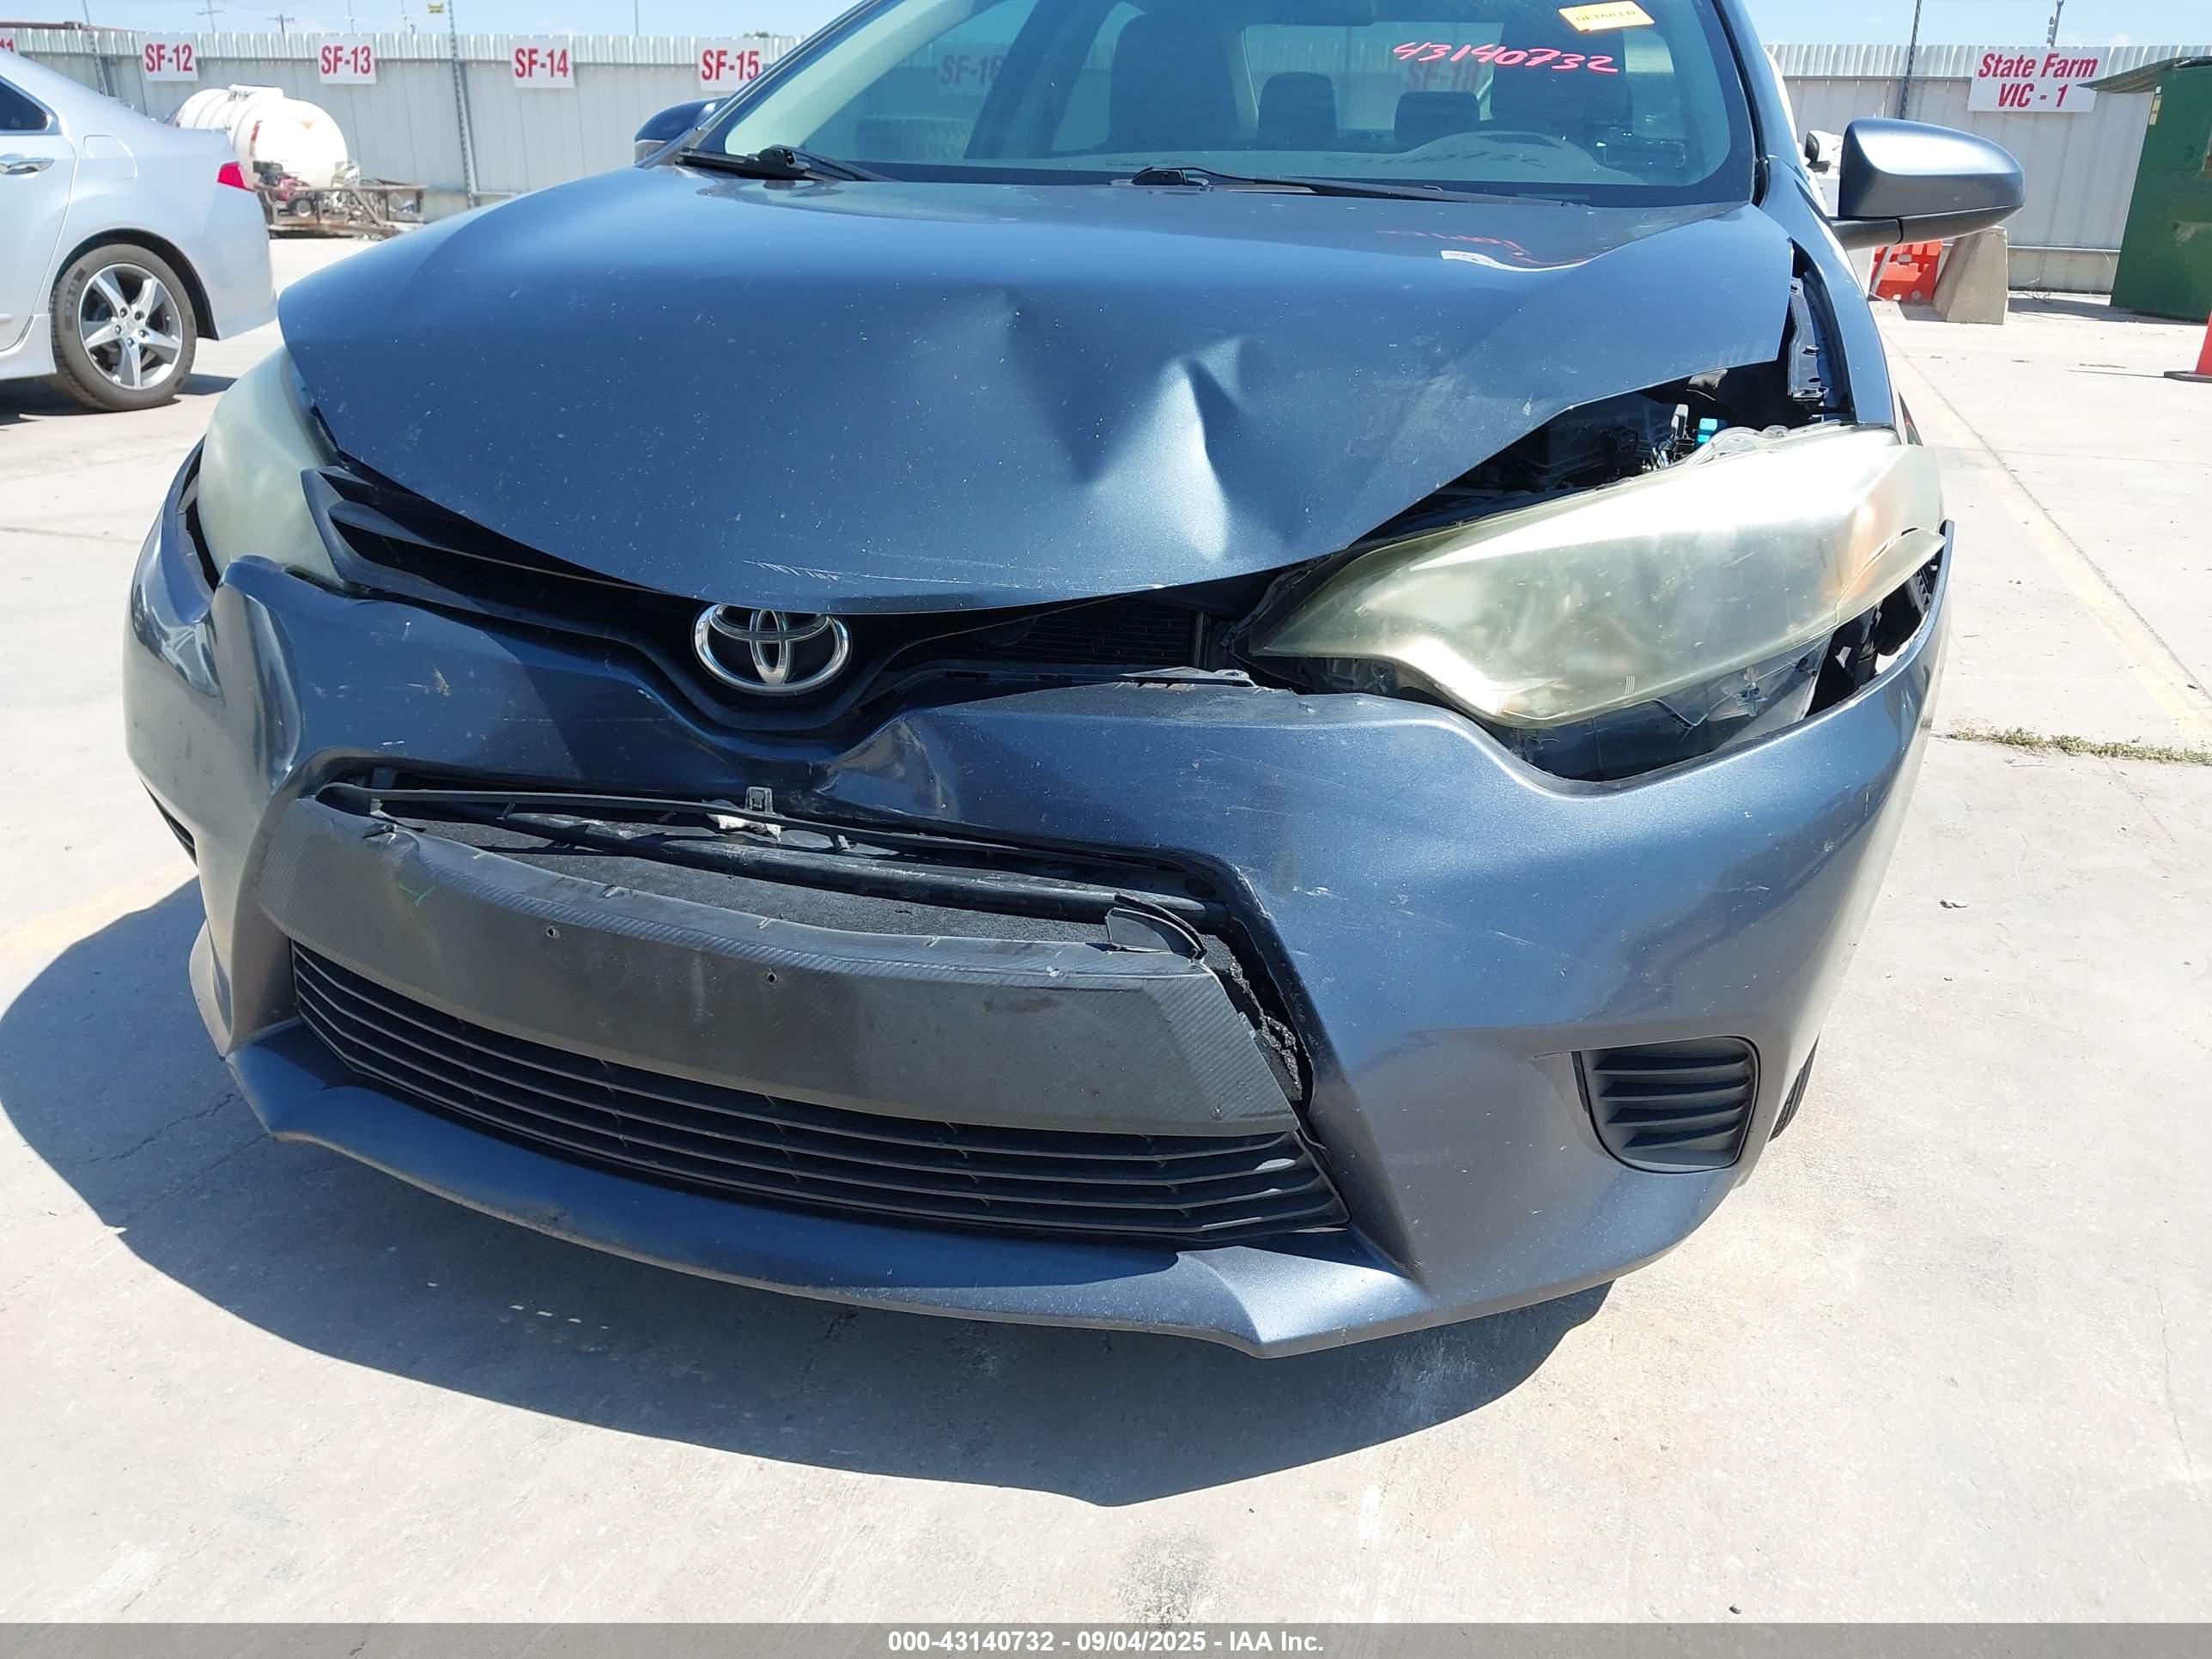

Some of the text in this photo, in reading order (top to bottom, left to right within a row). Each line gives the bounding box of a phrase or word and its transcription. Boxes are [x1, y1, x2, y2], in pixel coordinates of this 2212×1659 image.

[145, 44, 193, 72] SF-12
[320, 46, 372, 75] SF-13
[514, 48, 568, 77] SF-14
[702, 49, 760, 81] SF-15
[1393, 41, 1619, 73] 43140732
[1978, 52, 2098, 78] State Farm
[1998, 83, 2034, 107] VIC
[2056, 84, 2069, 107] 1
